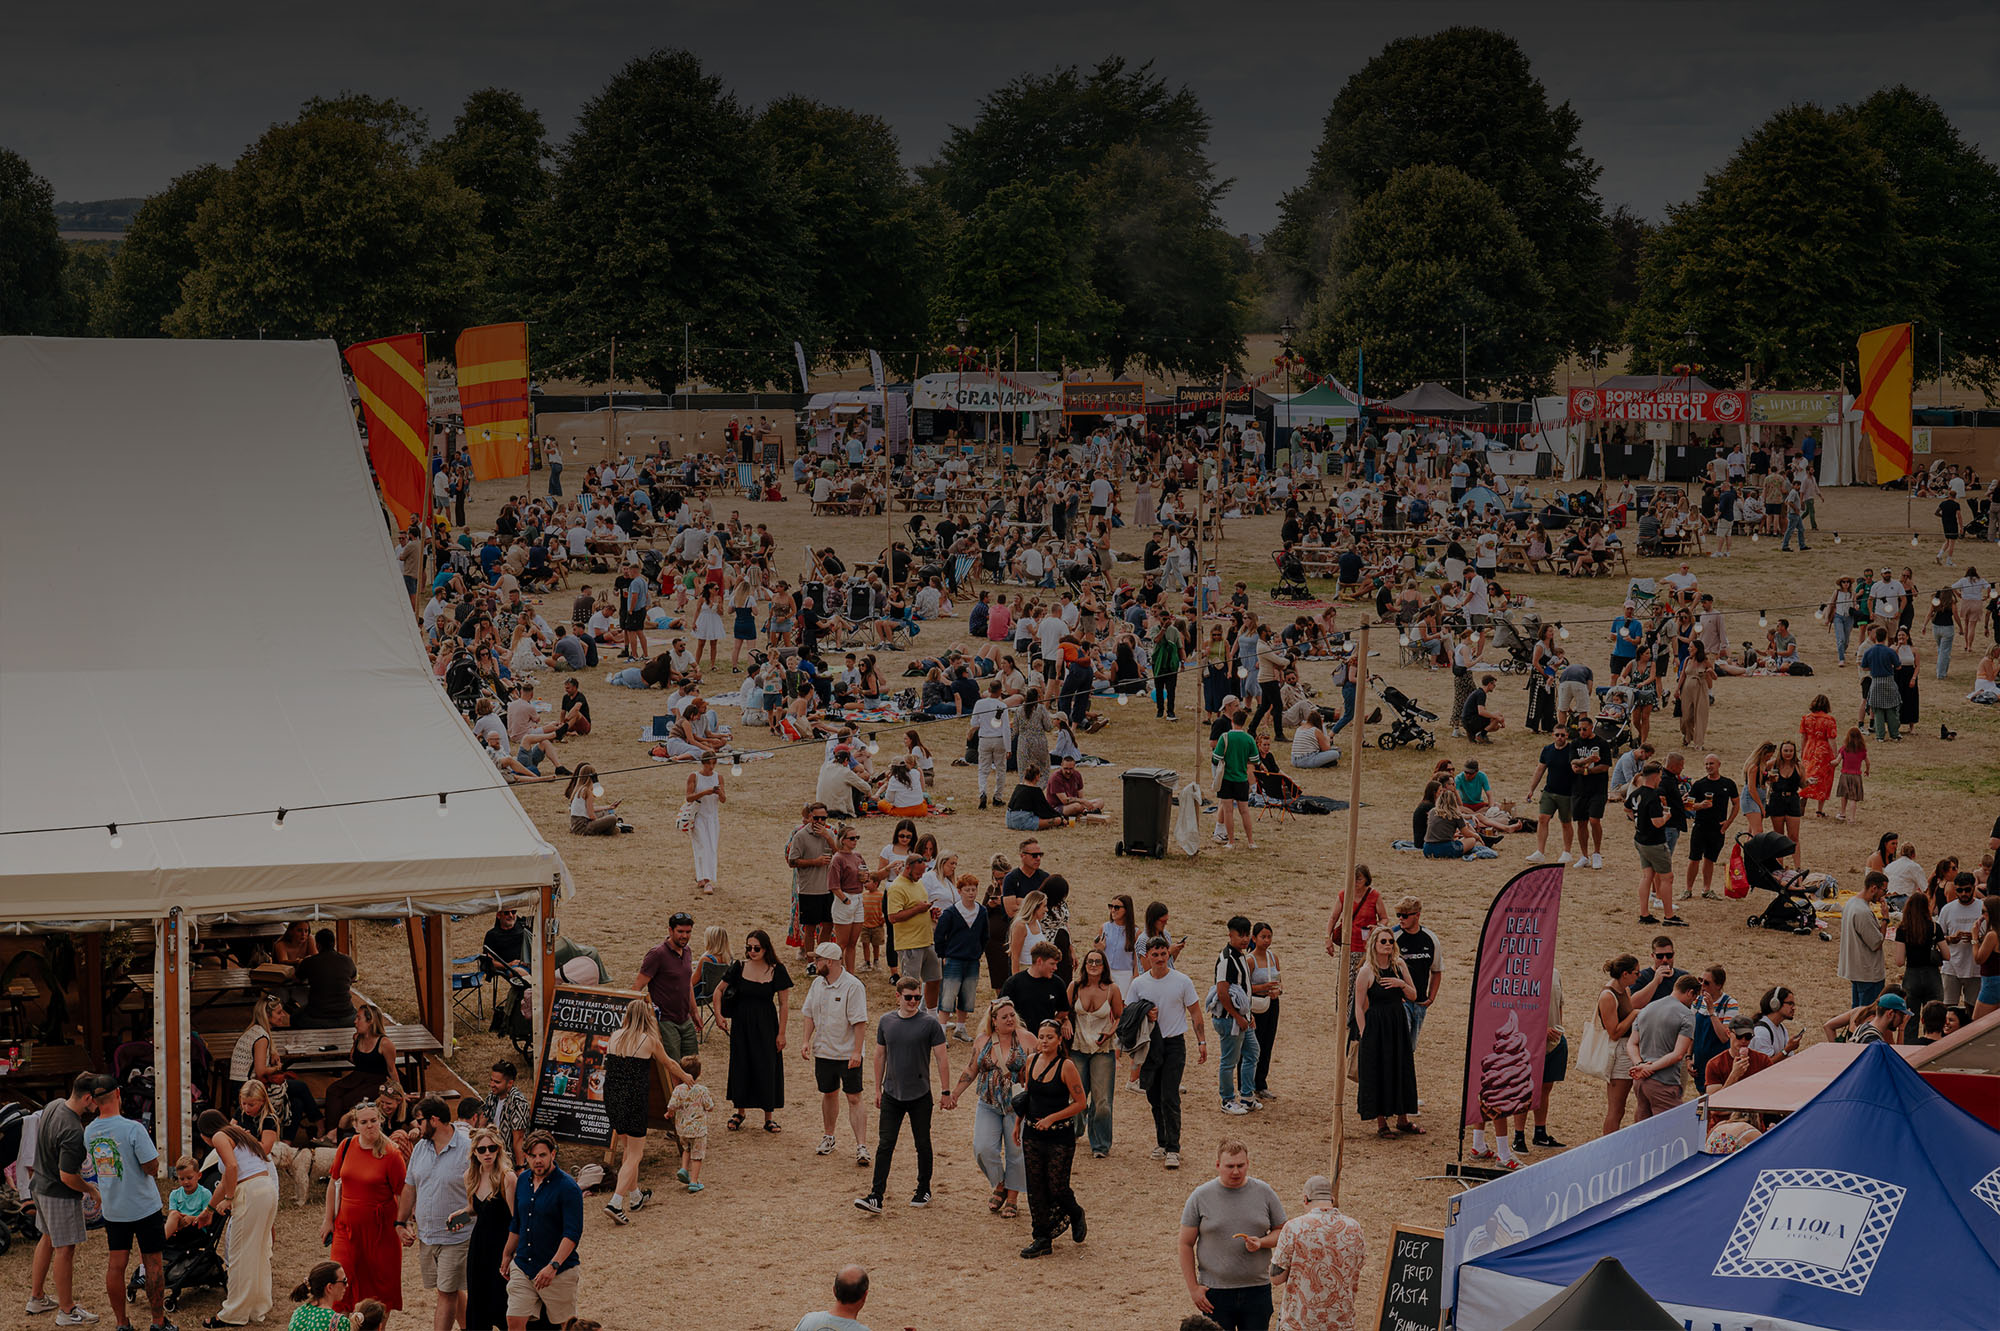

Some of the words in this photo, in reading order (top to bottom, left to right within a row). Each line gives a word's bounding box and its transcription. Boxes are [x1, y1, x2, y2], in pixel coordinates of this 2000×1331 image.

[955, 390, 1032, 405] GRANARY
[1180, 390, 1214, 400] DANNY'S
[1216, 391, 1250, 402] BRGERS
[1606, 390, 1640, 402] BORN
[1657, 392, 1708, 404] BREWED
[1770, 399, 1797, 410] WINE
[1800, 400, 1822, 410] BAR
[1628, 403, 1708, 420] BRISTOL
[1506, 916, 1540, 934] REAL
[1499, 937, 1542, 955] FRUIT
[1506, 958, 1531, 976] ICE
[1491, 976, 1540, 997] CREAM
[558, 998, 575, 1006] AFTER
[601, 1002, 615, 1010] JOIN
[560, 1006, 626, 1028] CLIFTON
[558, 1021, 597, 1032] COCKTAIL
[588, 1120, 610, 1129] SELECTED
[1770, 1217, 1792, 1230] LA
[1798, 1218, 1844, 1239] LOLA
[1398, 1240, 1430, 1260] DEEP
[1402, 1264, 1434, 1282] FRIED
[1390, 1282, 1429, 1306] PASTA
[1388, 1306, 1398, 1320] by
